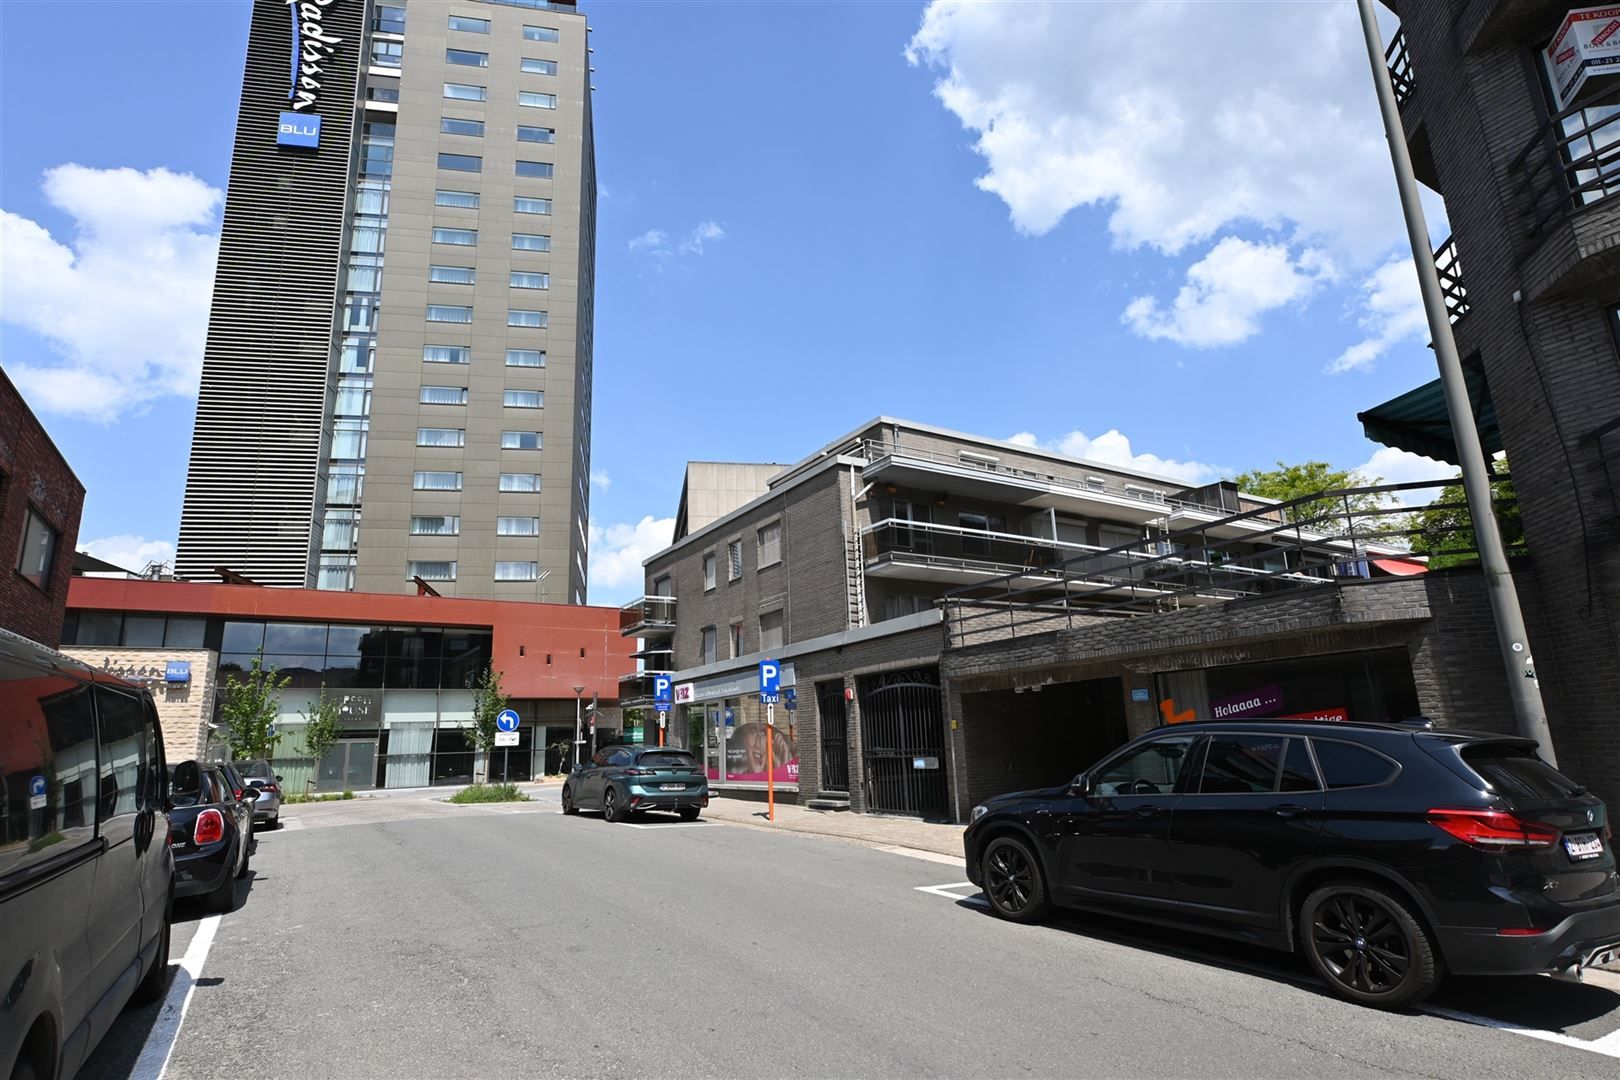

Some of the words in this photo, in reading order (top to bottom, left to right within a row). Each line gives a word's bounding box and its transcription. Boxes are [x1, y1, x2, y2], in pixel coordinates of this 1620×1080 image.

[280, 124, 317, 136] BLU
[763, 665, 777, 687] P
[656, 679, 669, 696] P
[762, 693, 779, 703] Taxi
[1214, 697, 1261, 718] Holaaaa
